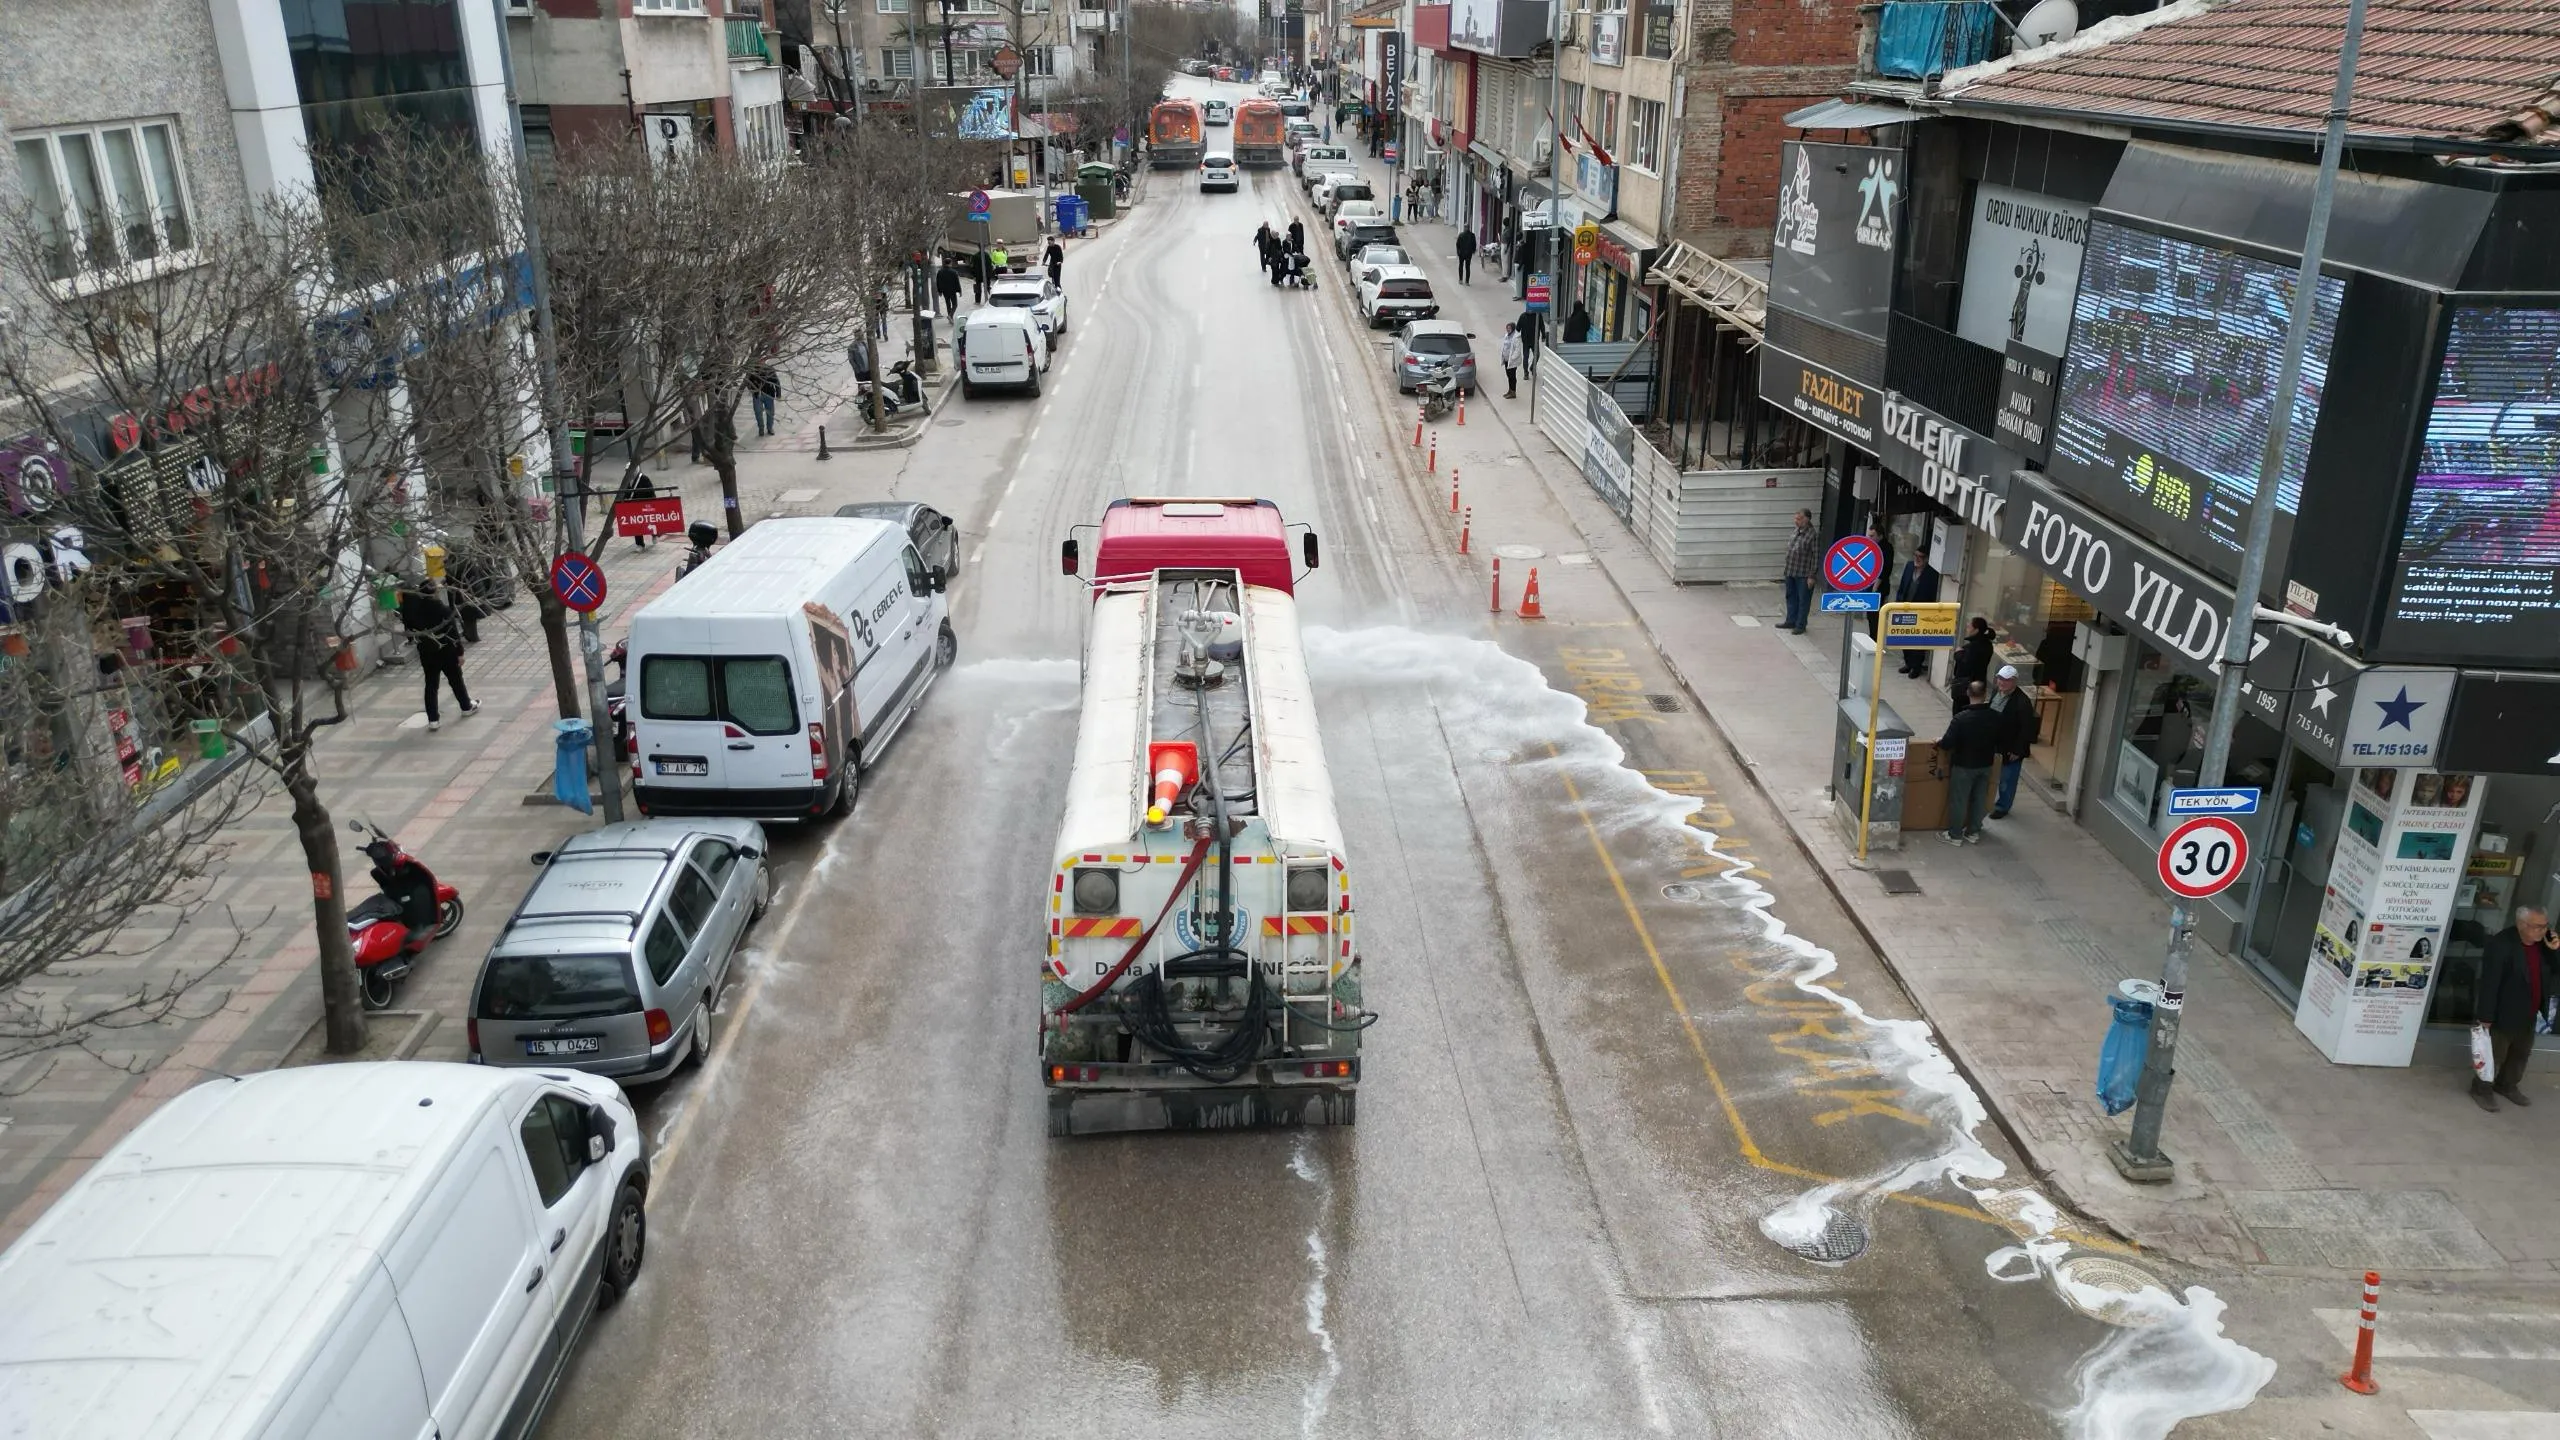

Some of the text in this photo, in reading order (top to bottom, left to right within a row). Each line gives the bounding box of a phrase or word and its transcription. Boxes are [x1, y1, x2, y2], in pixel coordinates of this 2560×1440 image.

[1385, 44, 1396, 111] BEYAZ
[1986, 198, 2013, 228] ORDU
[2014, 204, 2051, 237] HUKUK
[1576, 250, 1591, 259] ria
[1802, 369, 1864, 418] FAZİLET
[1882, 390, 1968, 474] ÖZLEM
[2023, 420, 2043, 445] ORDU
[1921, 460, 2006, 538] OPTİK
[2019, 500, 2111, 594] FOTO
[1923, 627, 1952, 635] DURAĞI
[2256, 690, 2278, 713] 1952
[2297, 713, 2336, 749] 715 13 64
[2399, 743, 2411, 755] 13
[2411, 744, 2428, 755] 64
[2180, 796, 2229, 807] TEK YÖN
[2175, 840, 2231, 876] 30
[532, 1038, 597, 1052] 16 Y 0429
